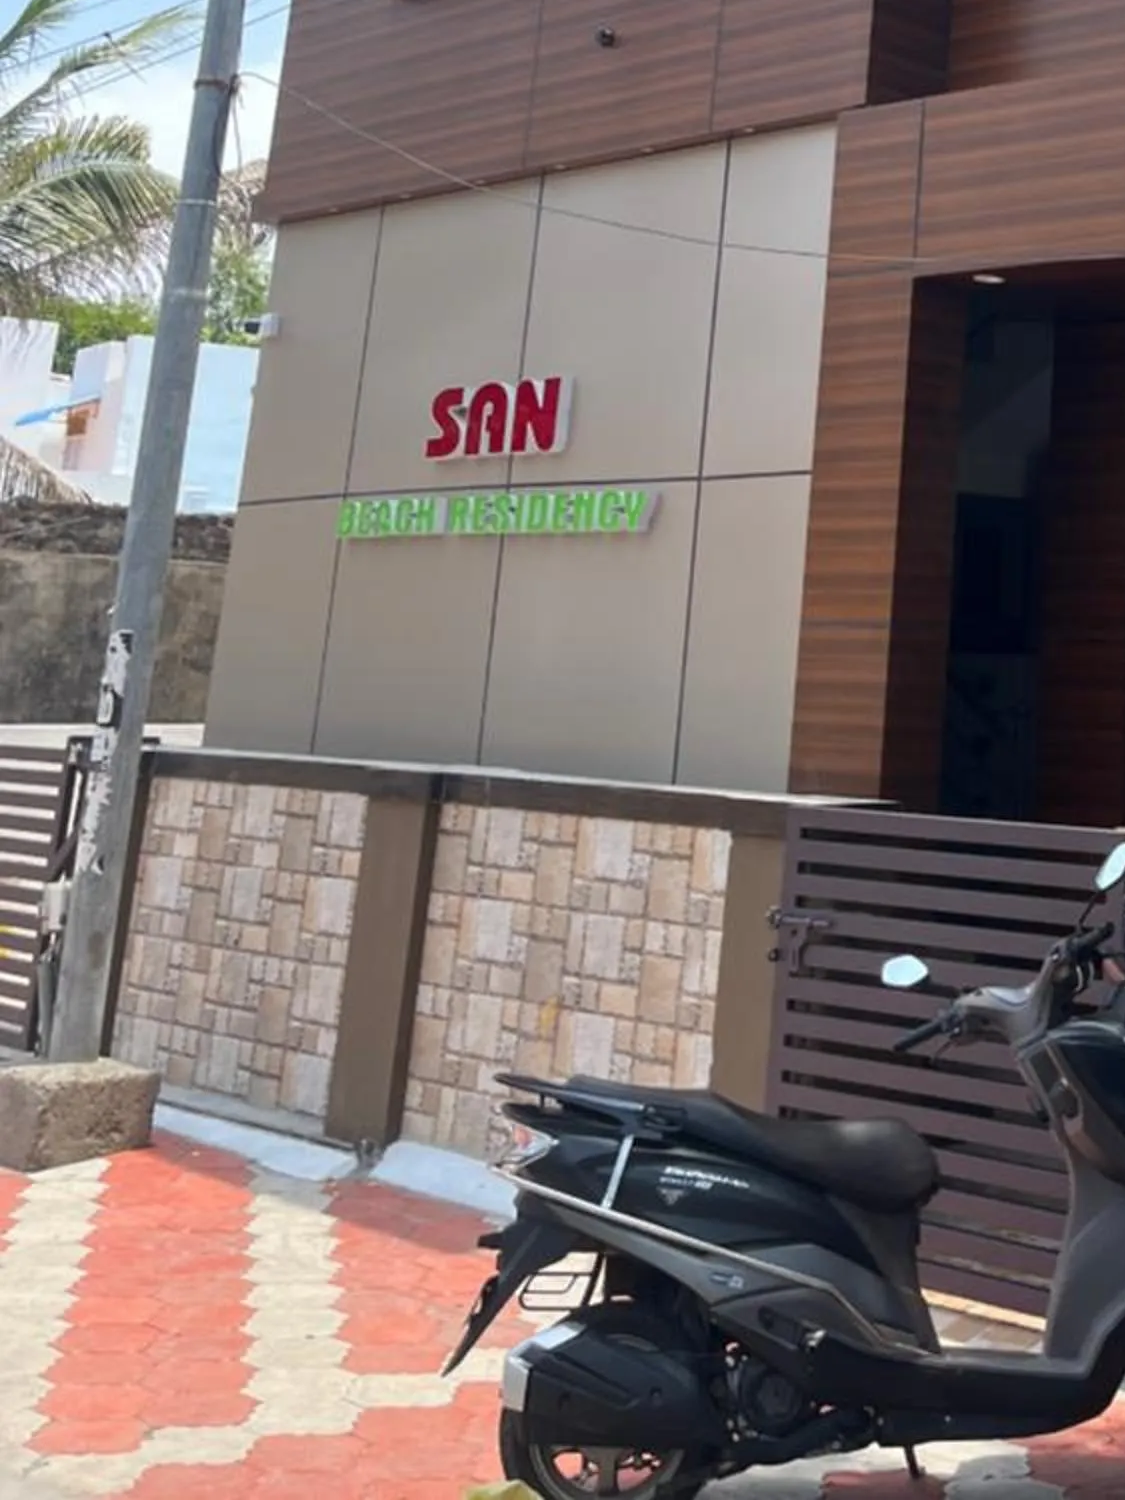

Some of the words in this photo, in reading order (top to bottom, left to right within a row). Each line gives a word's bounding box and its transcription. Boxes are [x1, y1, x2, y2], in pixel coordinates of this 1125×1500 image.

[425, 377, 562, 458] SAN
[337, 498, 436, 537] BEACH
[449, 490, 646, 534] RESIDENCY
